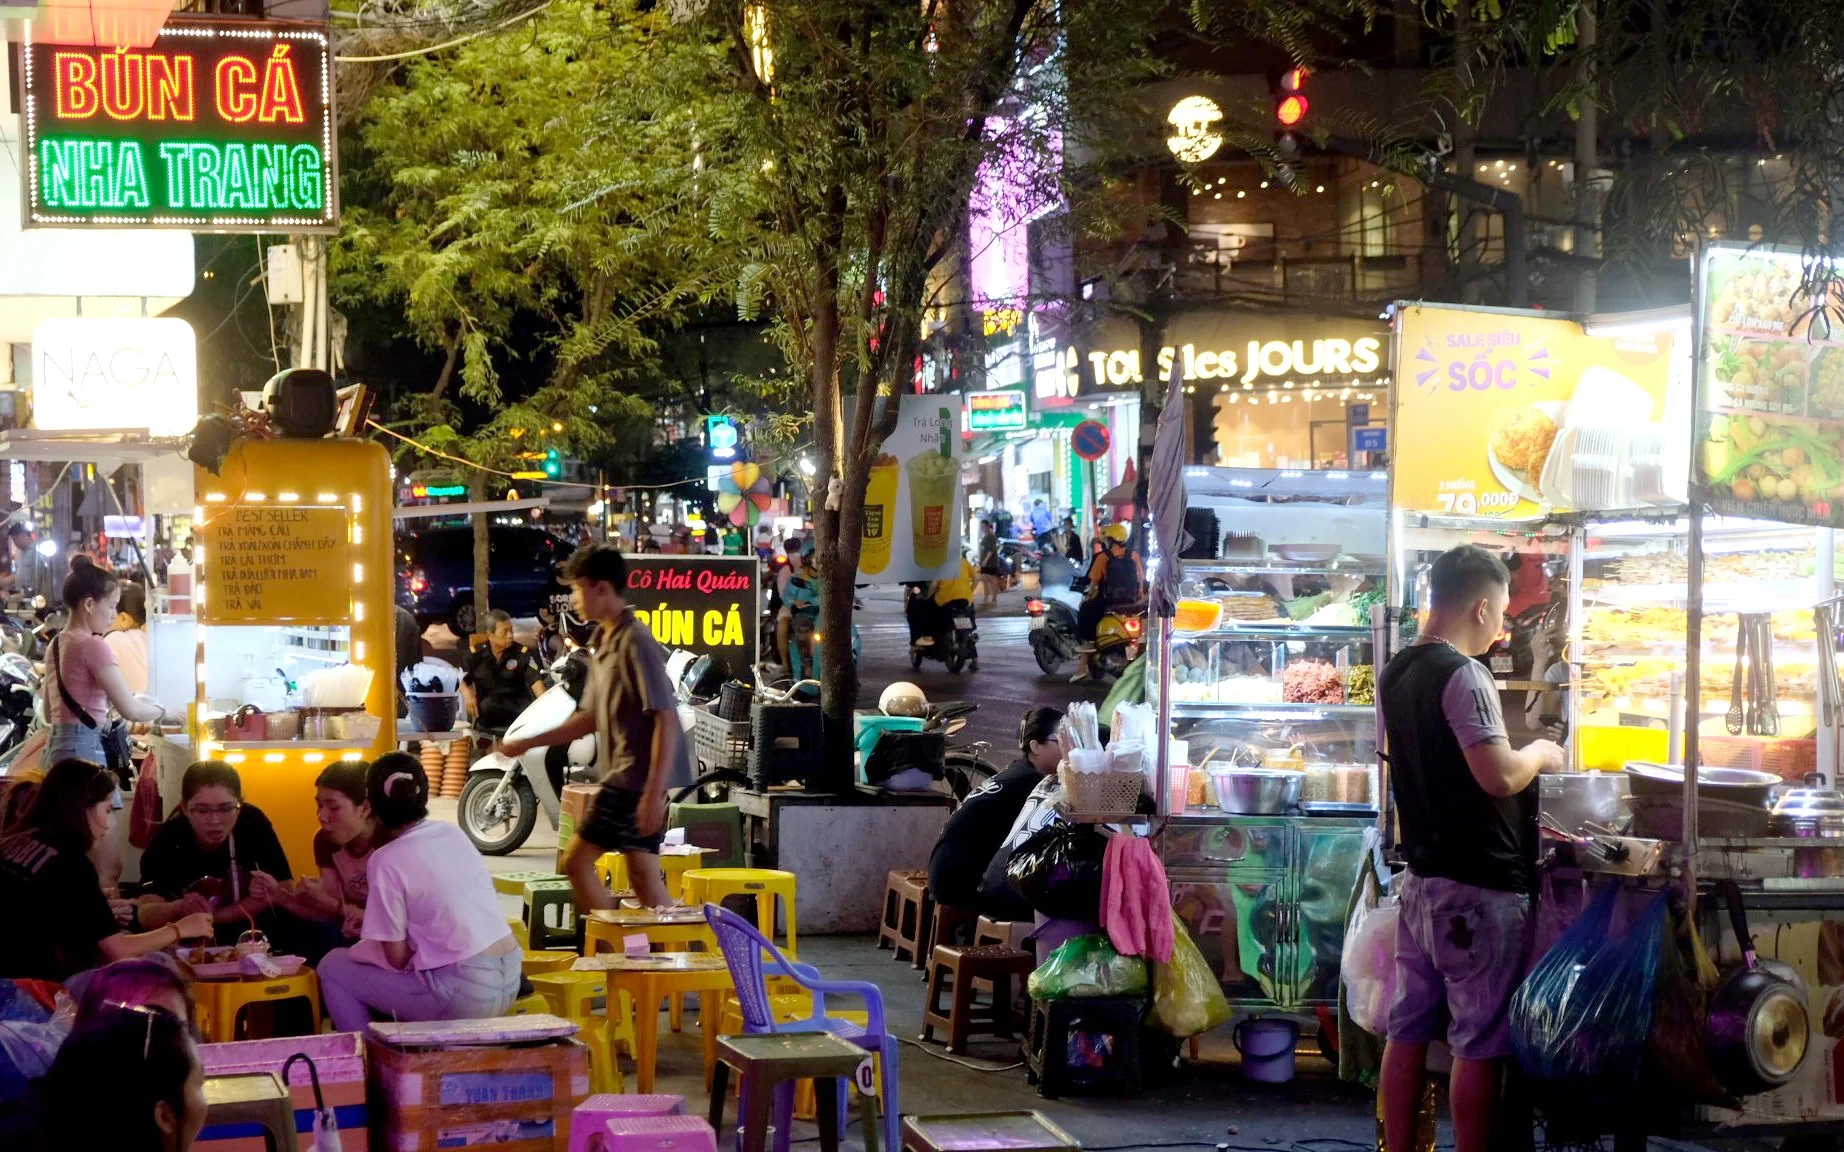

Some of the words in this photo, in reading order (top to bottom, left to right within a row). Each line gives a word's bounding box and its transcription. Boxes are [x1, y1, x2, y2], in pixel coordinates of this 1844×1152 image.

[56, 45, 194, 121] BÚN
[216, 44, 304, 123] CÁ
[41, 139, 148, 208] NHA
[160, 142, 322, 210] TRANG
[1447, 333, 1485, 348] SALE
[43, 347, 180, 387] NAGA
[1183, 343, 1237, 380] les
[1241, 338, 1380, 386] JOURS
[1448, 348, 1517, 391] SỐC
[913, 416, 927, 428] Trà
[236, 510, 263, 522] BEST
[267, 509, 309, 522] SELLER
[627, 569, 652, 589] Cô
[656, 568, 691, 590] Hai
[697, 570, 750, 594] Quán
[703, 603, 745, 647] CÁ
